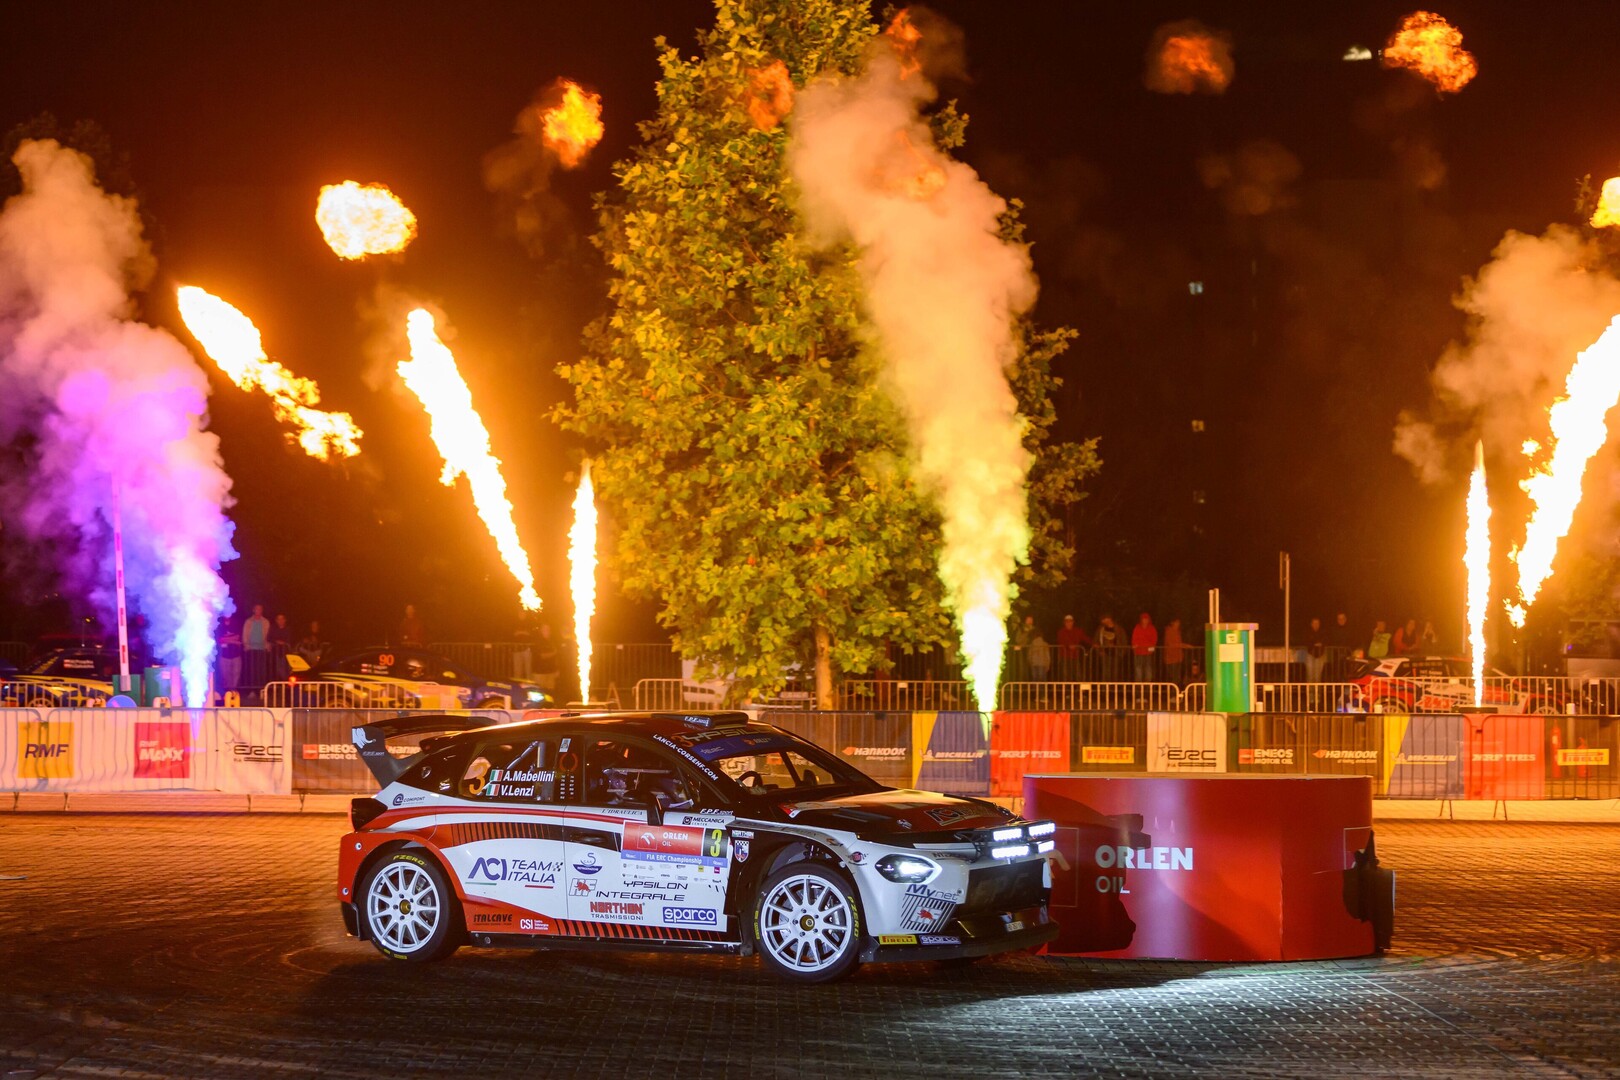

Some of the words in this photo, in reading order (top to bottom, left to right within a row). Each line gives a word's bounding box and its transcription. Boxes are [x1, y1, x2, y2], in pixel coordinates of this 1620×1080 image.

[379, 654, 394, 666] 90
[25, 744, 69, 758] RMF
[318, 744, 357, 754] ENEOS
[935, 751, 984, 759] MICHELIN
[1167, 749, 1217, 761] ERC
[1254, 748, 1293, 758] ENEOS
[469, 762, 488, 795] 3
[503, 770, 555, 782] A.Mabellini
[501, 785, 534, 797] V.Lenzi
[662, 831, 689, 841] ORLEN
[710, 829, 722, 857] 3
[667, 856, 703, 865] Championship
[1095, 844, 1193, 870] ORLEN
[468, 856, 508, 881] ACI
[511, 860, 552, 872] TEAM
[507, 871, 556, 883] ITALIA
[623, 880, 689, 890] YPSILON
[1095, 875, 1130, 894] OIL
[595, 890, 685, 901] INTEGRALE
[906, 883, 960, 900] Mynet
[664, 908, 716, 923] sparco
[520, 918, 534, 929] CSI
[881, 935, 913, 943] PIRELLI
